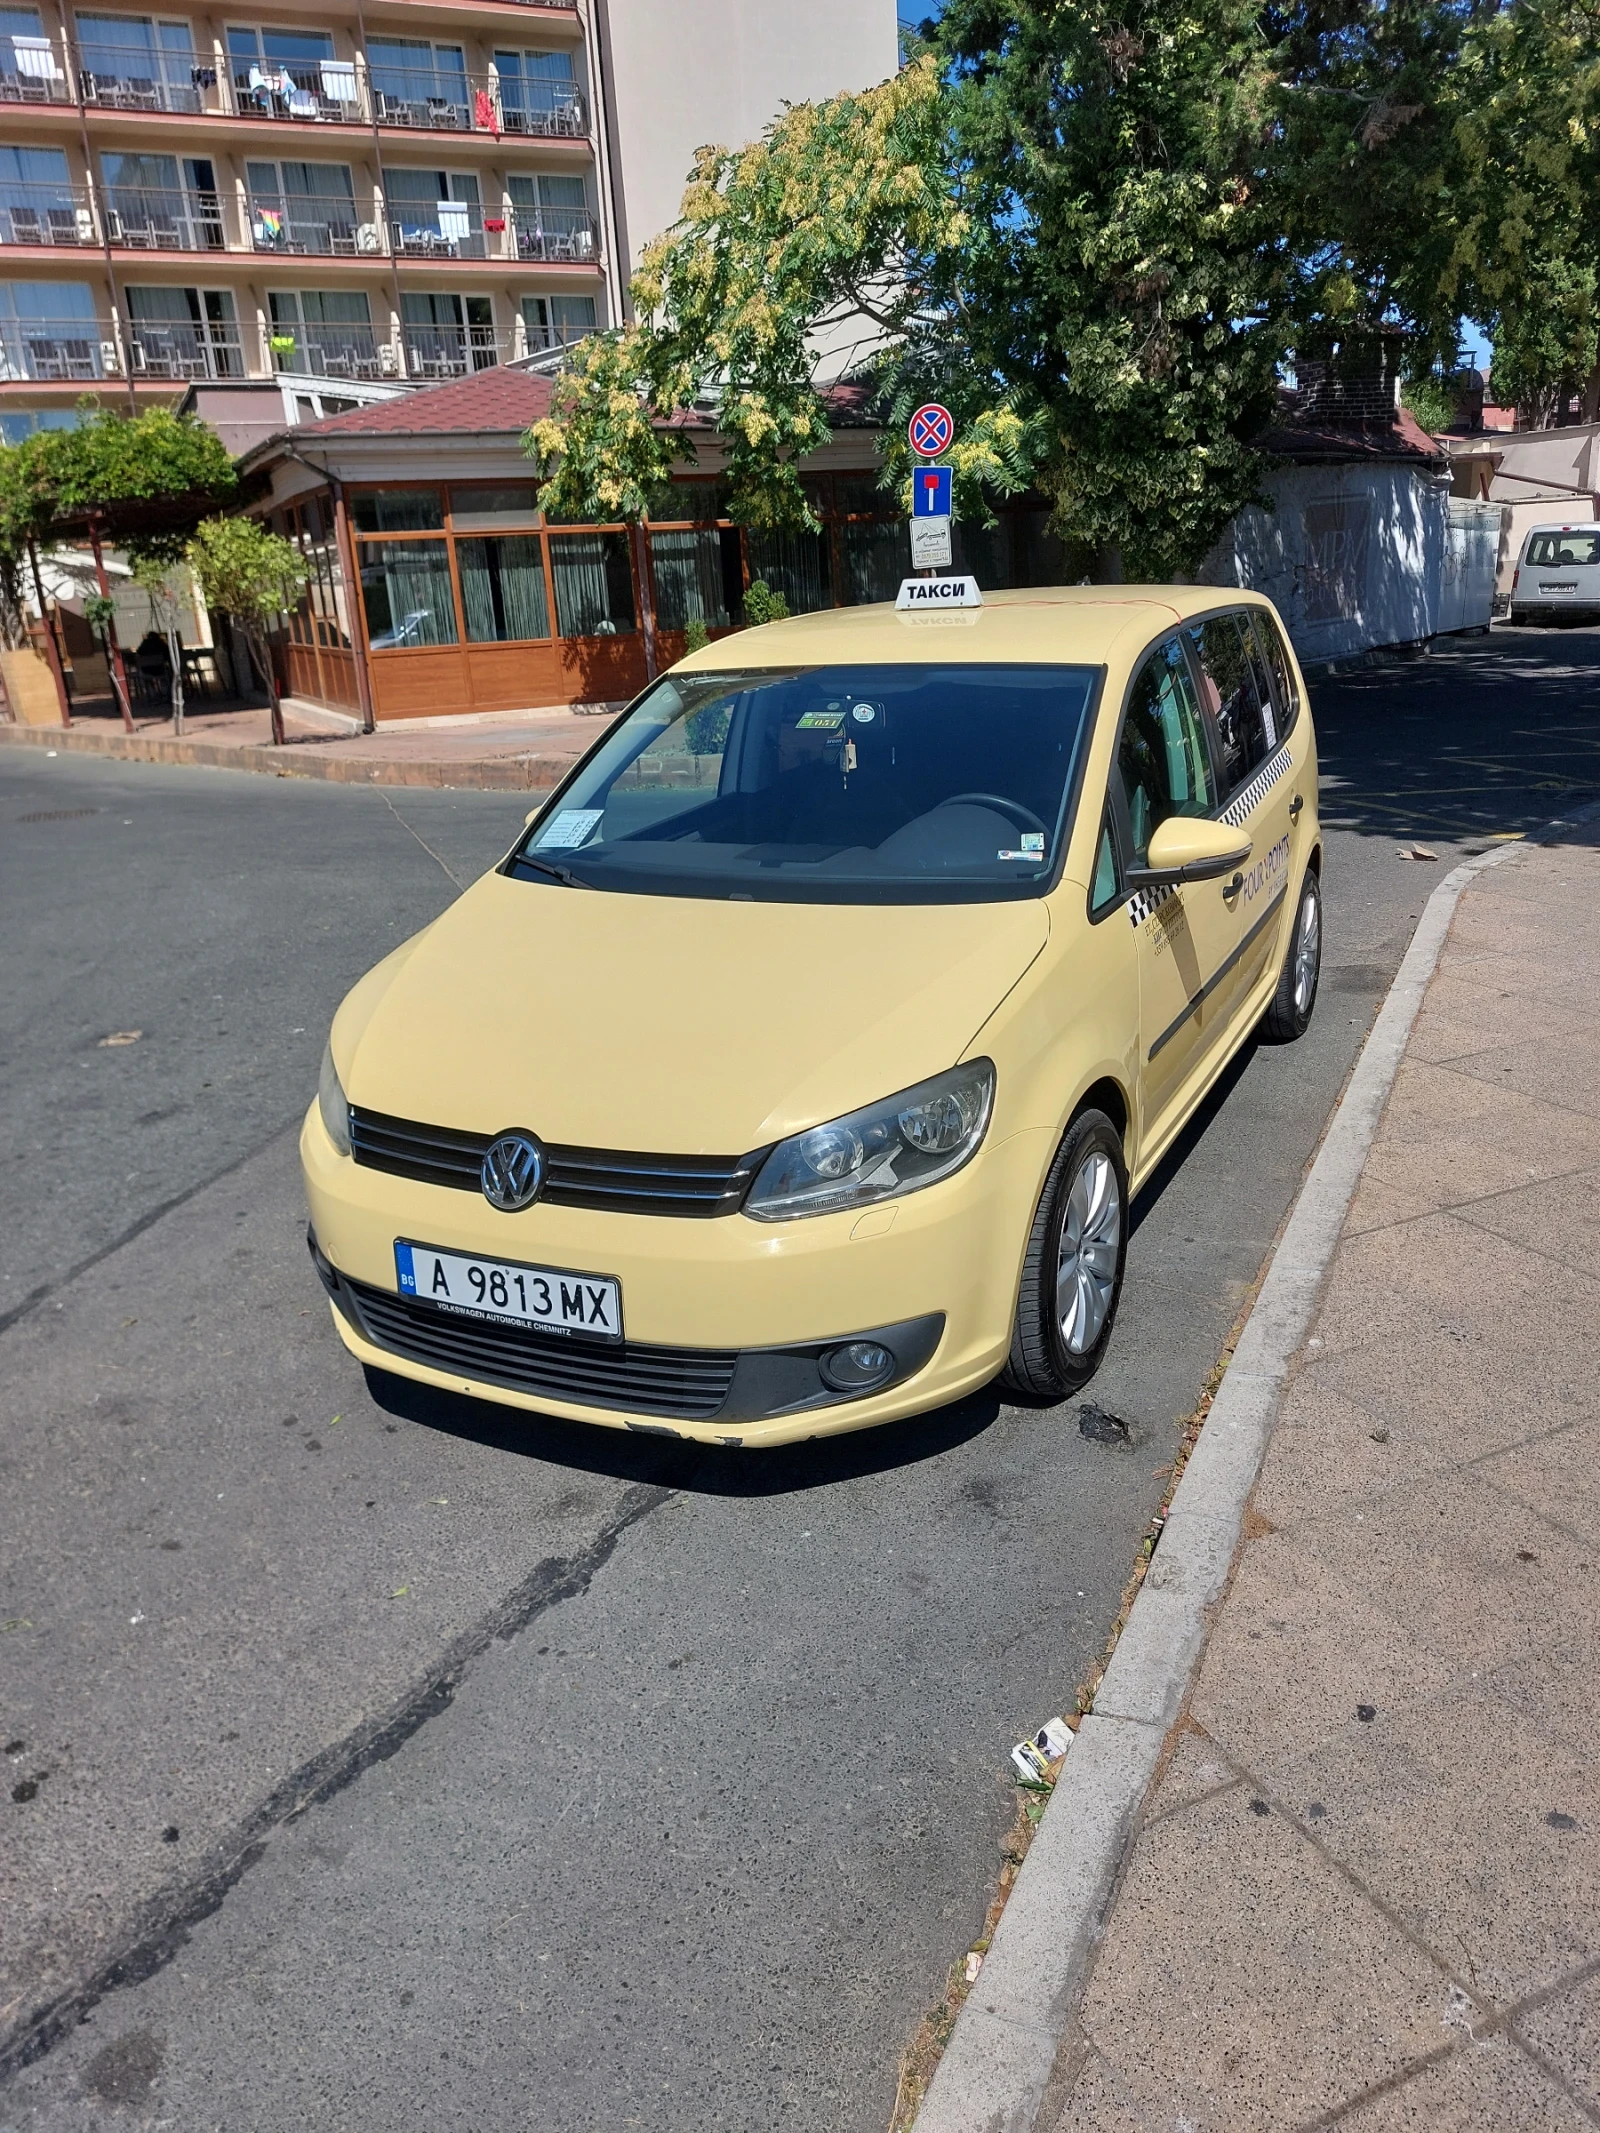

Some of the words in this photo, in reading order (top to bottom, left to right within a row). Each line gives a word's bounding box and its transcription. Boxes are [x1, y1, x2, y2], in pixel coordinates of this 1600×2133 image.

[907, 583, 965, 599] ТАКСИ
[1243, 861, 1265, 907] FOUR
[1268, 832, 1290, 878] POINTS
[401, 1273, 415, 1287] BG
[432, 1257, 451, 1297] A
[436, 1301, 486, 1320] VOLKSWAGEN
[486, 1312, 533, 1330] AUTOMOBILE
[533, 1321, 572, 1336] CHEMNITZ
